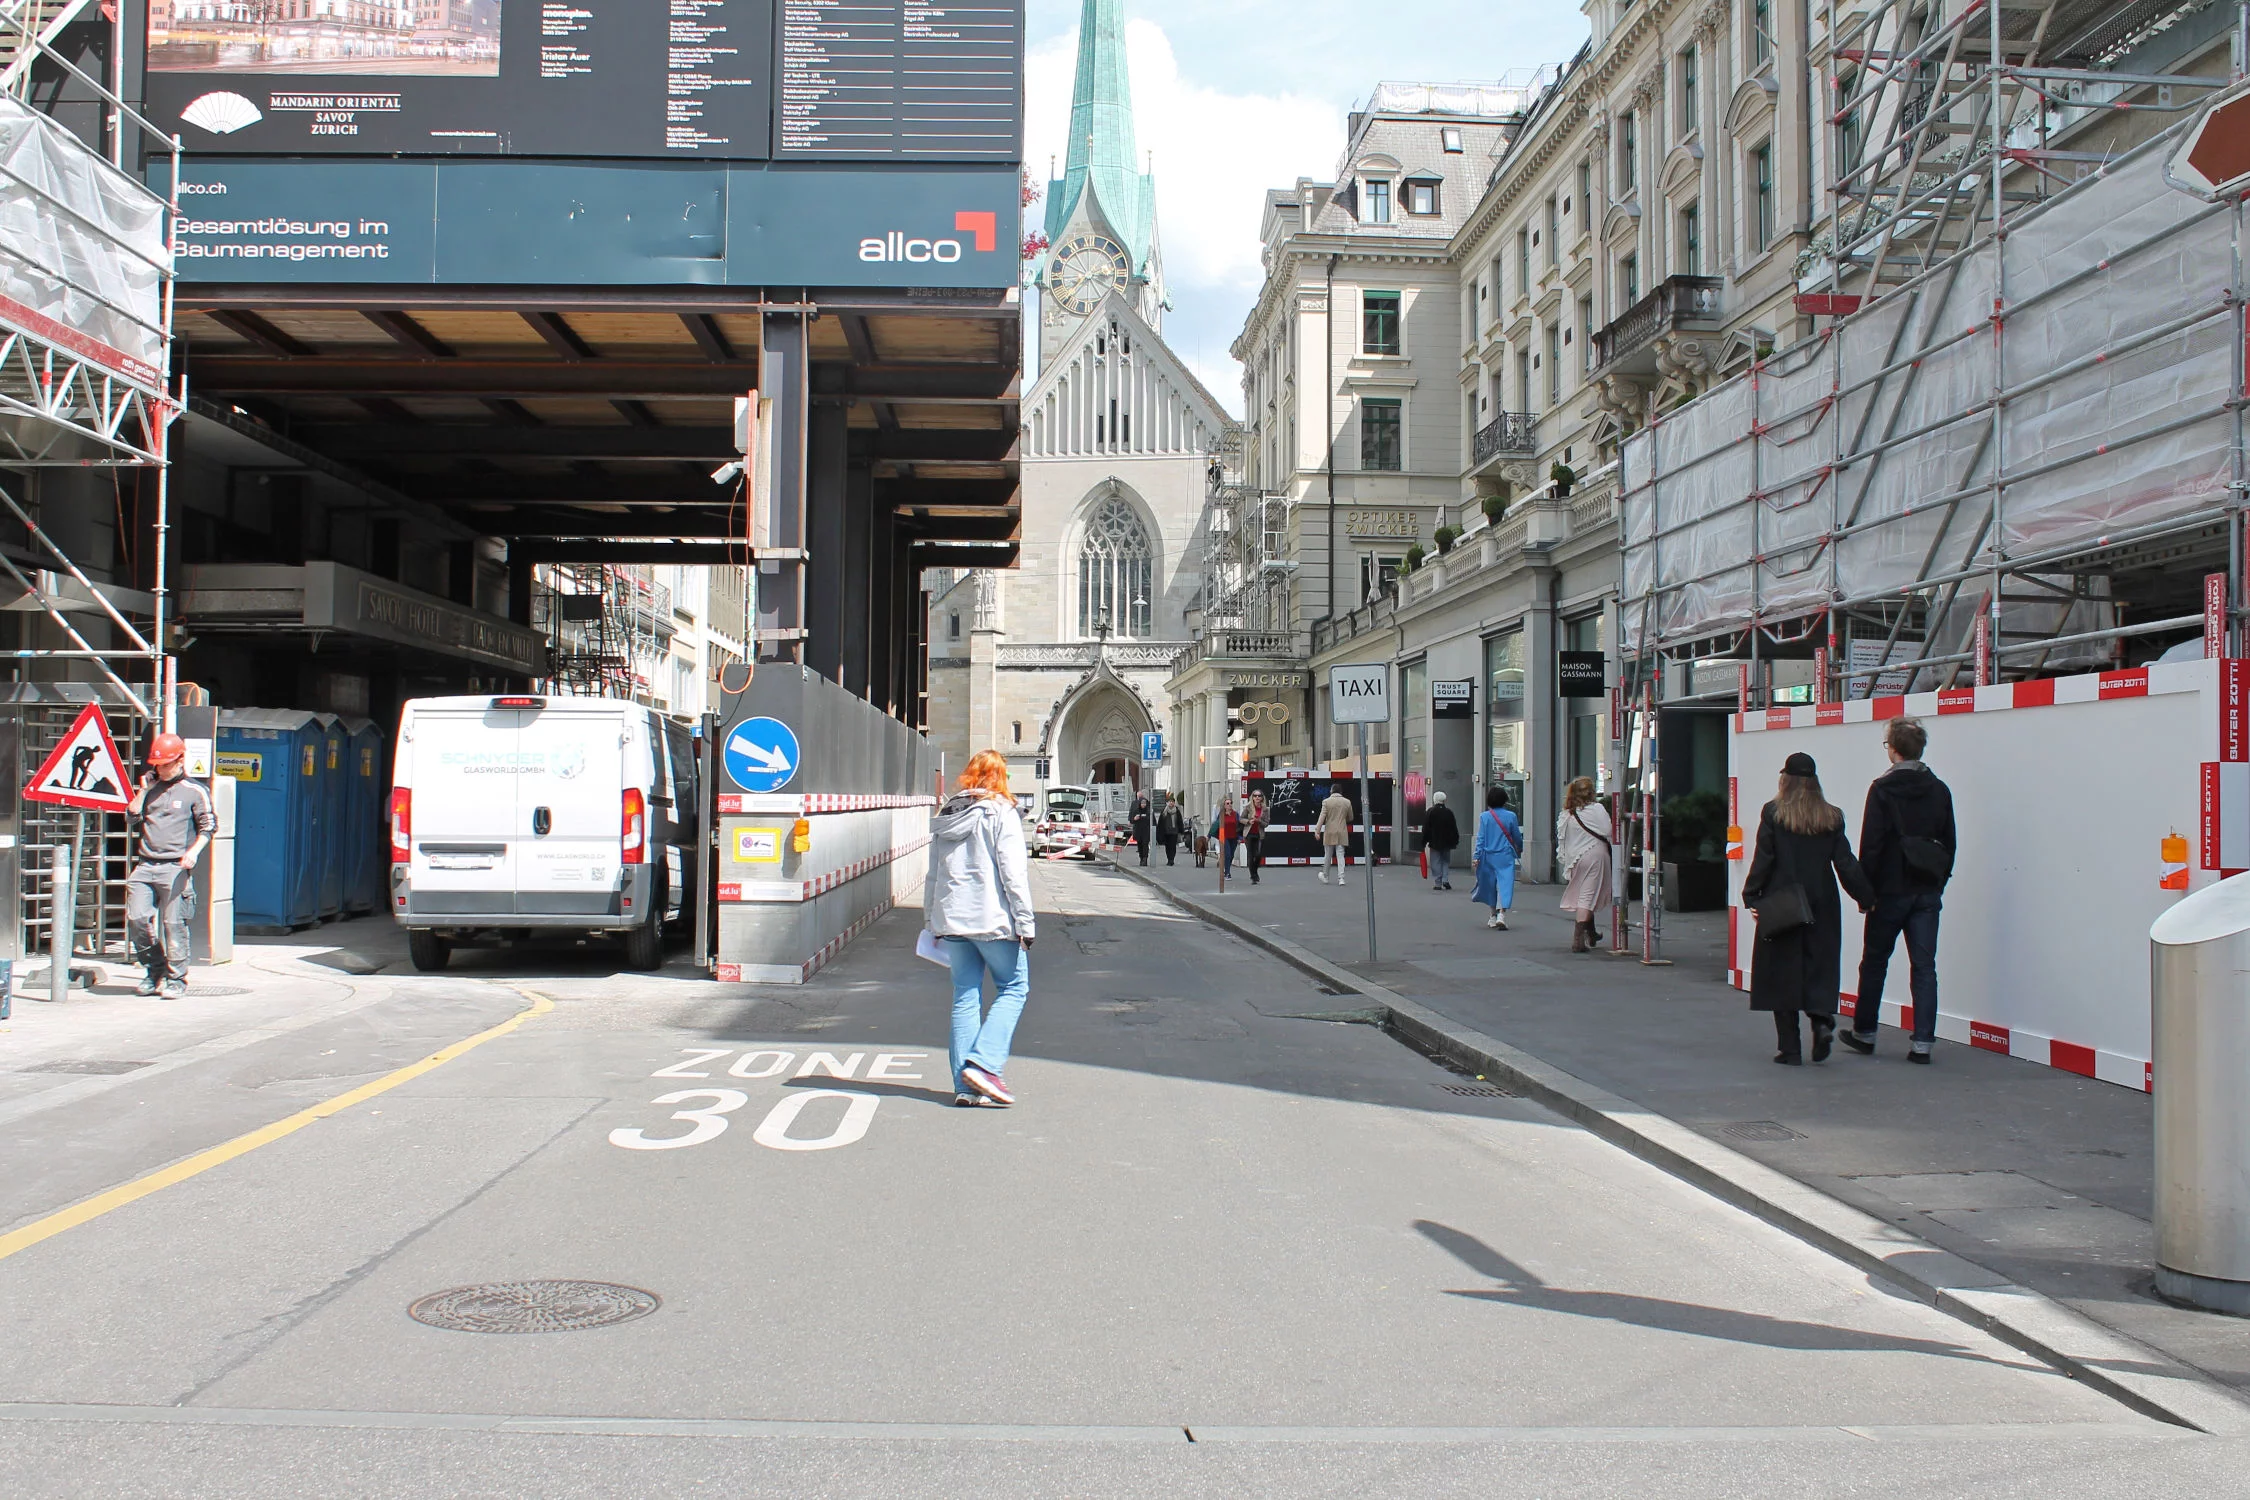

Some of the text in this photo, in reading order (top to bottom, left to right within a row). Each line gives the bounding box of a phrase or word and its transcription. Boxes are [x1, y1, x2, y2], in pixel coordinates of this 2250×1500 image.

[542, 52, 590, 60] Tristan Auer
[270, 97, 401, 109] MANDARIN ORIENTAL
[316, 112, 354, 123] SAVOY
[310, 125, 358, 136] ZURICH
[176, 217, 388, 238] Gesamtlösung im
[174, 242, 389, 262] Baumanagement
[859, 230, 961, 262] allco
[1348, 512, 1417, 524] OPTIKER
[1345, 524, 1419, 536] ZWICKER
[370, 592, 401, 624] SAVOY
[408, 604, 440, 639] HOTEL
[2212, 580, 2220, 659] roth gerüs
[1229, 674, 1301, 685] ZWICKER
[1561, 670, 1602, 678] GASSMANN
[1338, 678, 1382, 696] TAXI
[2100, 678, 2146, 689] SUTER ZOTTI
[1938, 698, 1956, 706] SUTER
[2229, 662, 2238, 760] SUTER ZOTTI
[1148, 736, 1157, 749] P
[440, 752, 544, 764] SCHNYDER
[464, 766, 545, 774] GLASWORLD GMBH
[1971, 1029, 2008, 1044] SUTER ZOTTI
[650, 1048, 928, 1080] ZONE
[608, 1088, 880, 1151] 30
